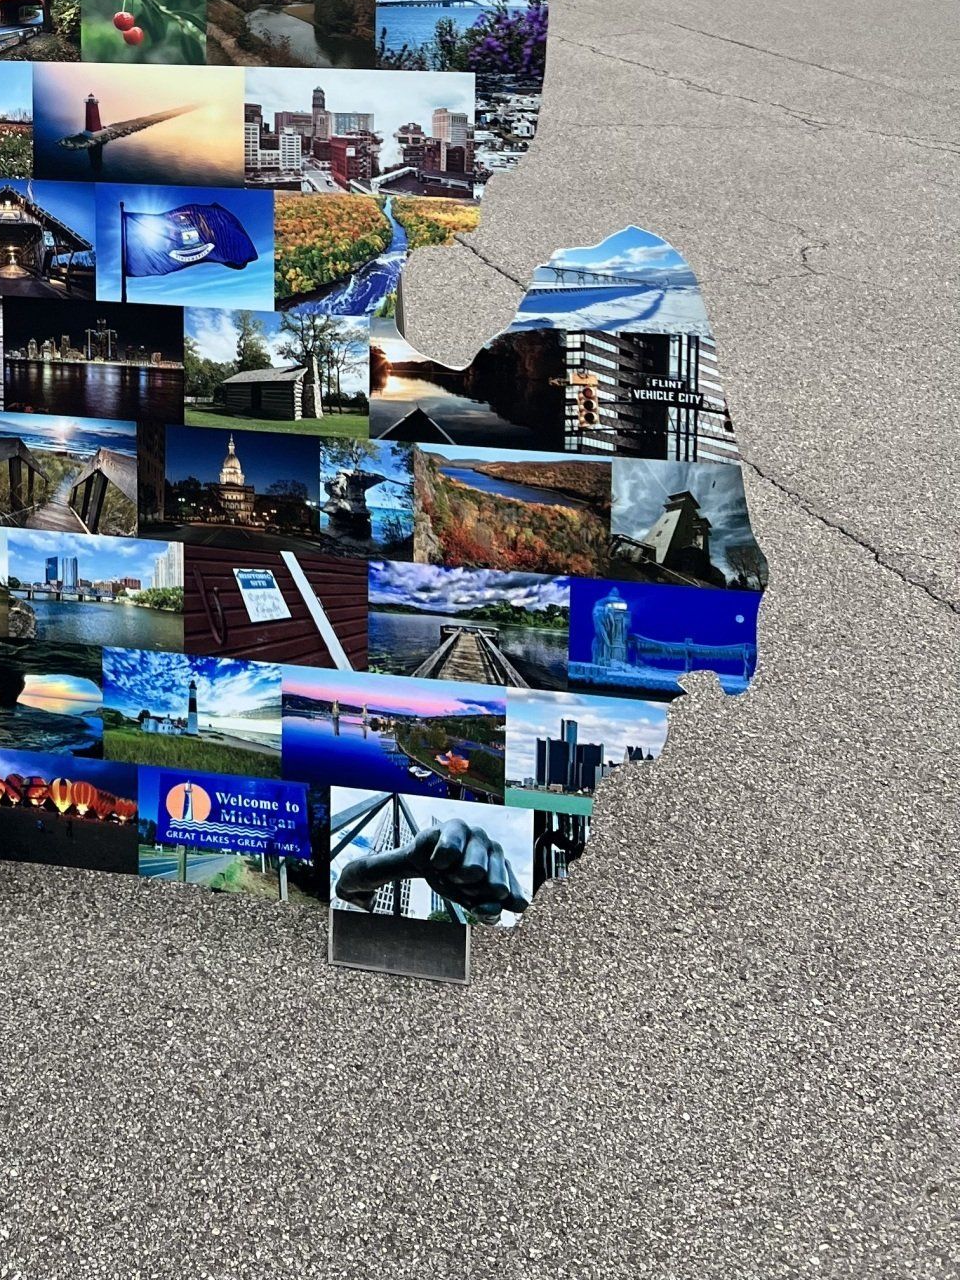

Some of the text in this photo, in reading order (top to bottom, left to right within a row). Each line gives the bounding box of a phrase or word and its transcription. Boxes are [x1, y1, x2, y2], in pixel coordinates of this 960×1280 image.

[651, 378, 683, 389] FLINT
[633, 389, 702, 404] VEHICLE CITY
[238, 572, 272, 580] HISTORIC
[215, 792, 300, 813] Welcome to
[220, 809, 296, 832] Michigan
[166, 830, 301, 853] GREAT LAKES GREAT TIMES
